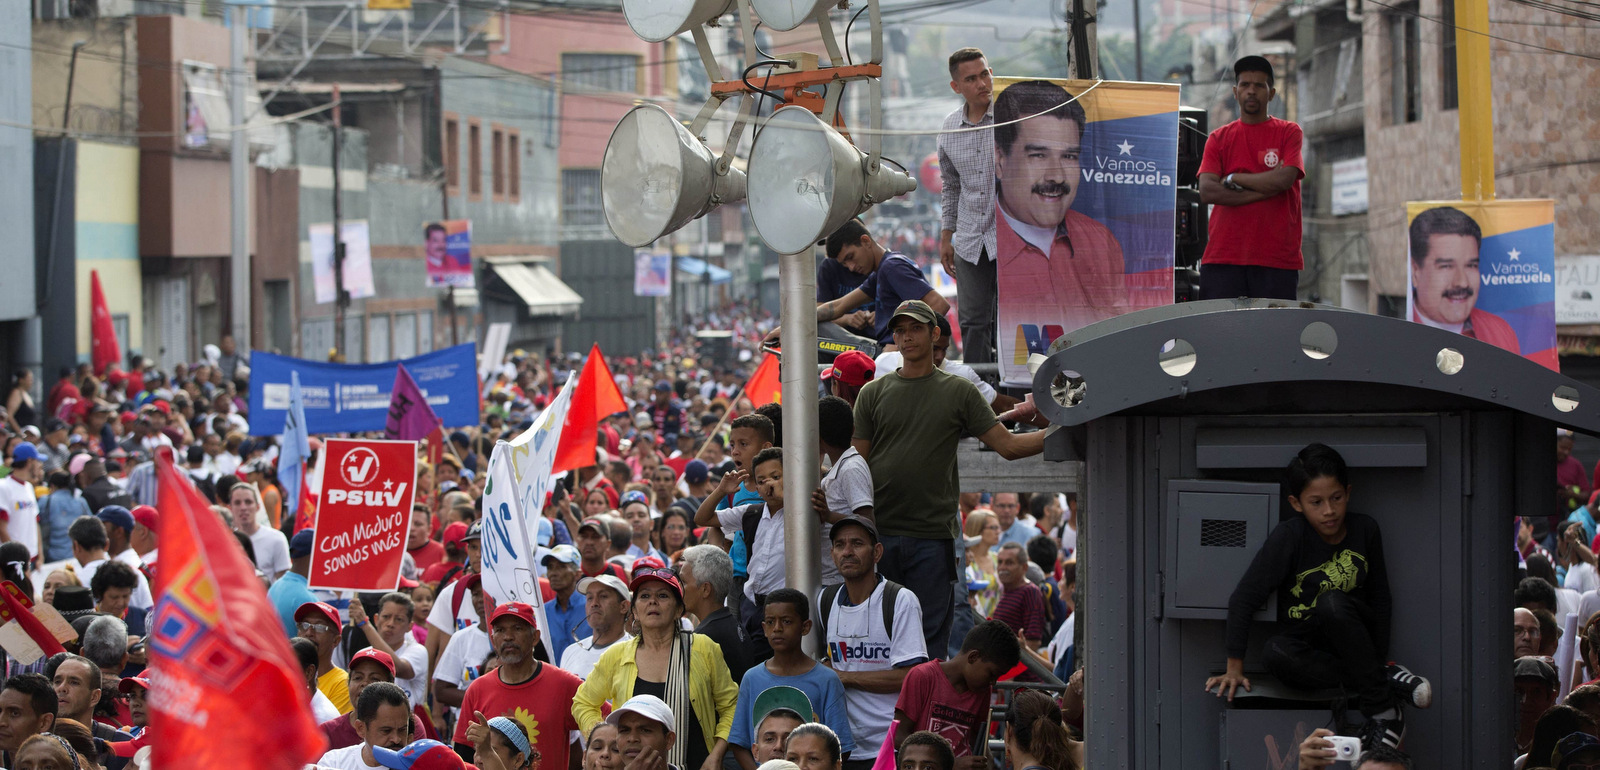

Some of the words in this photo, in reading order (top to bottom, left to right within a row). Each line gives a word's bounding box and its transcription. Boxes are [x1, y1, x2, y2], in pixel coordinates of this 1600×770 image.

[1095, 155, 1156, 172] Vamos
[1082, 168, 1171, 186] Venezuela
[1491, 262, 1540, 274] Vamos
[1481, 271, 1552, 286] Venezuela
[320, 531, 350, 553] Con
[353, 511, 403, 544] Maduro
[323, 545, 369, 575] somos
[371, 532, 400, 556] más
[933, 706, 954, 718] Gold
